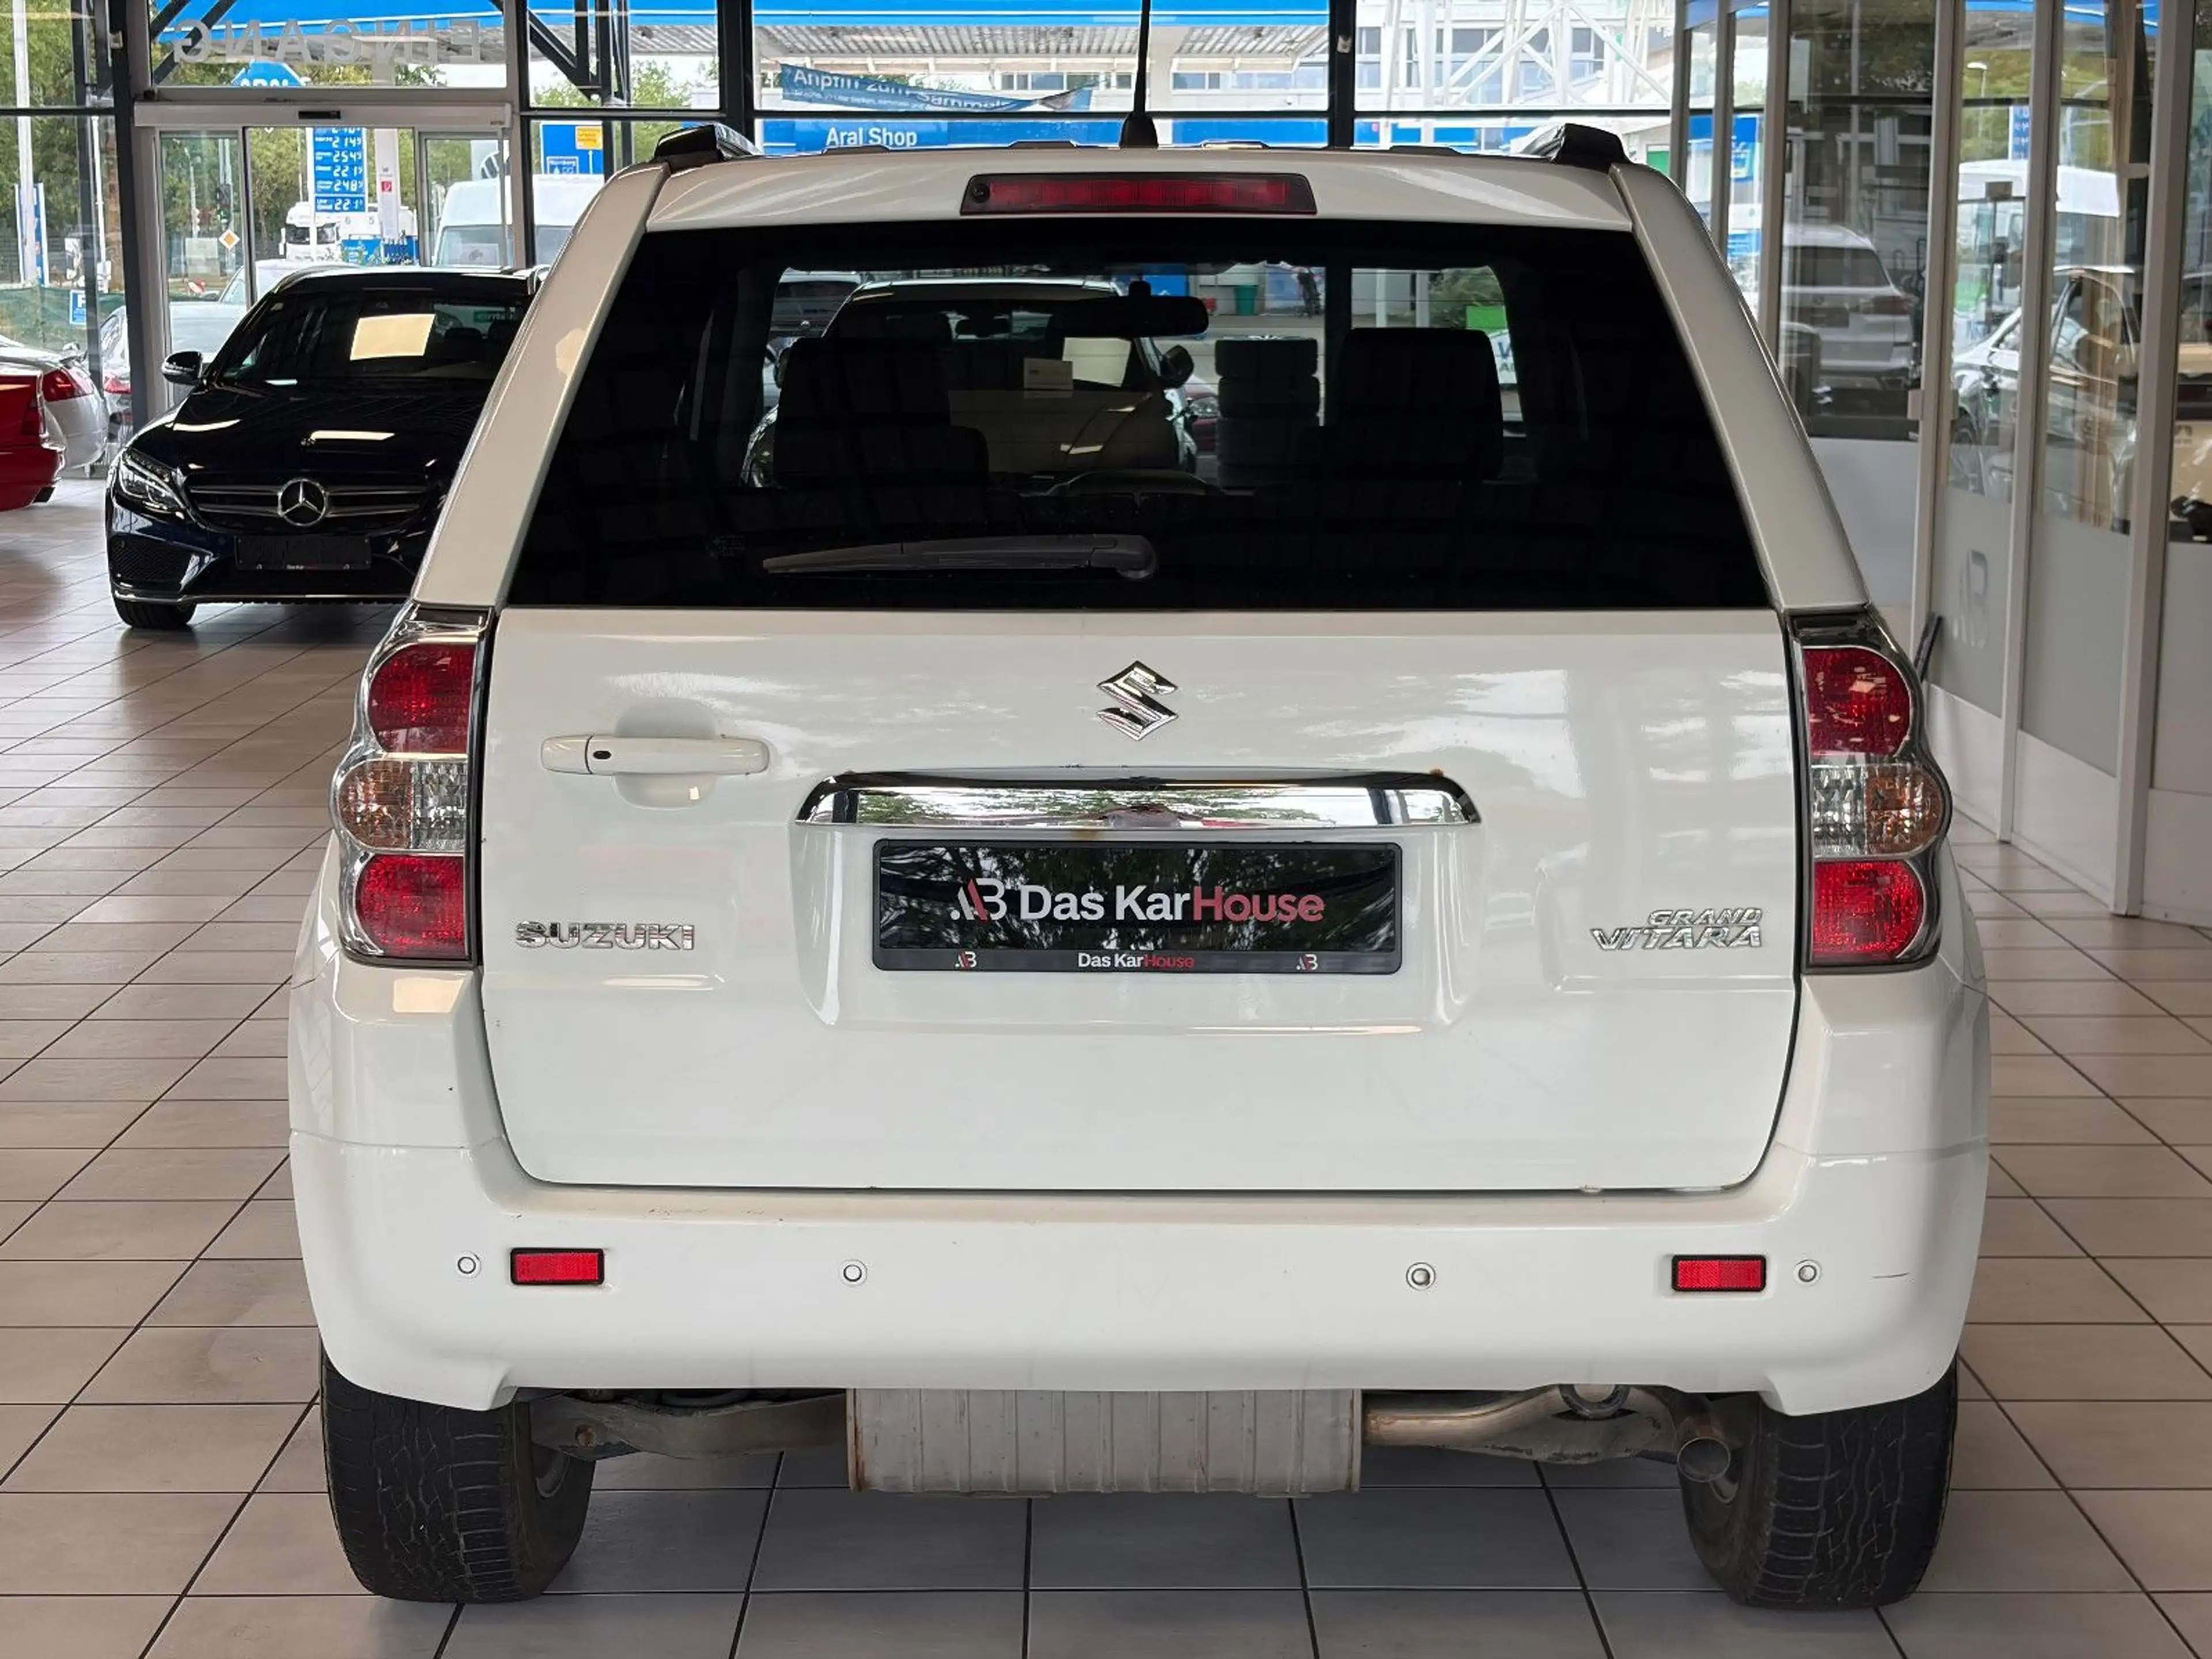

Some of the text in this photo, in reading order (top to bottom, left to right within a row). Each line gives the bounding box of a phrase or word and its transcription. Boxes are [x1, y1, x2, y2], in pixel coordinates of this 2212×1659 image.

[826, 127, 918, 147] Aral Shop
[1020, 884, 1105, 921] Das
[1115, 885, 1325, 922] KarHouse
[1647, 907, 1763, 926] GRAND
[516, 921, 695, 950] SUZUKI
[1590, 925, 1763, 951] VITARA
[1077, 952, 1195, 968] Das KarHouse
